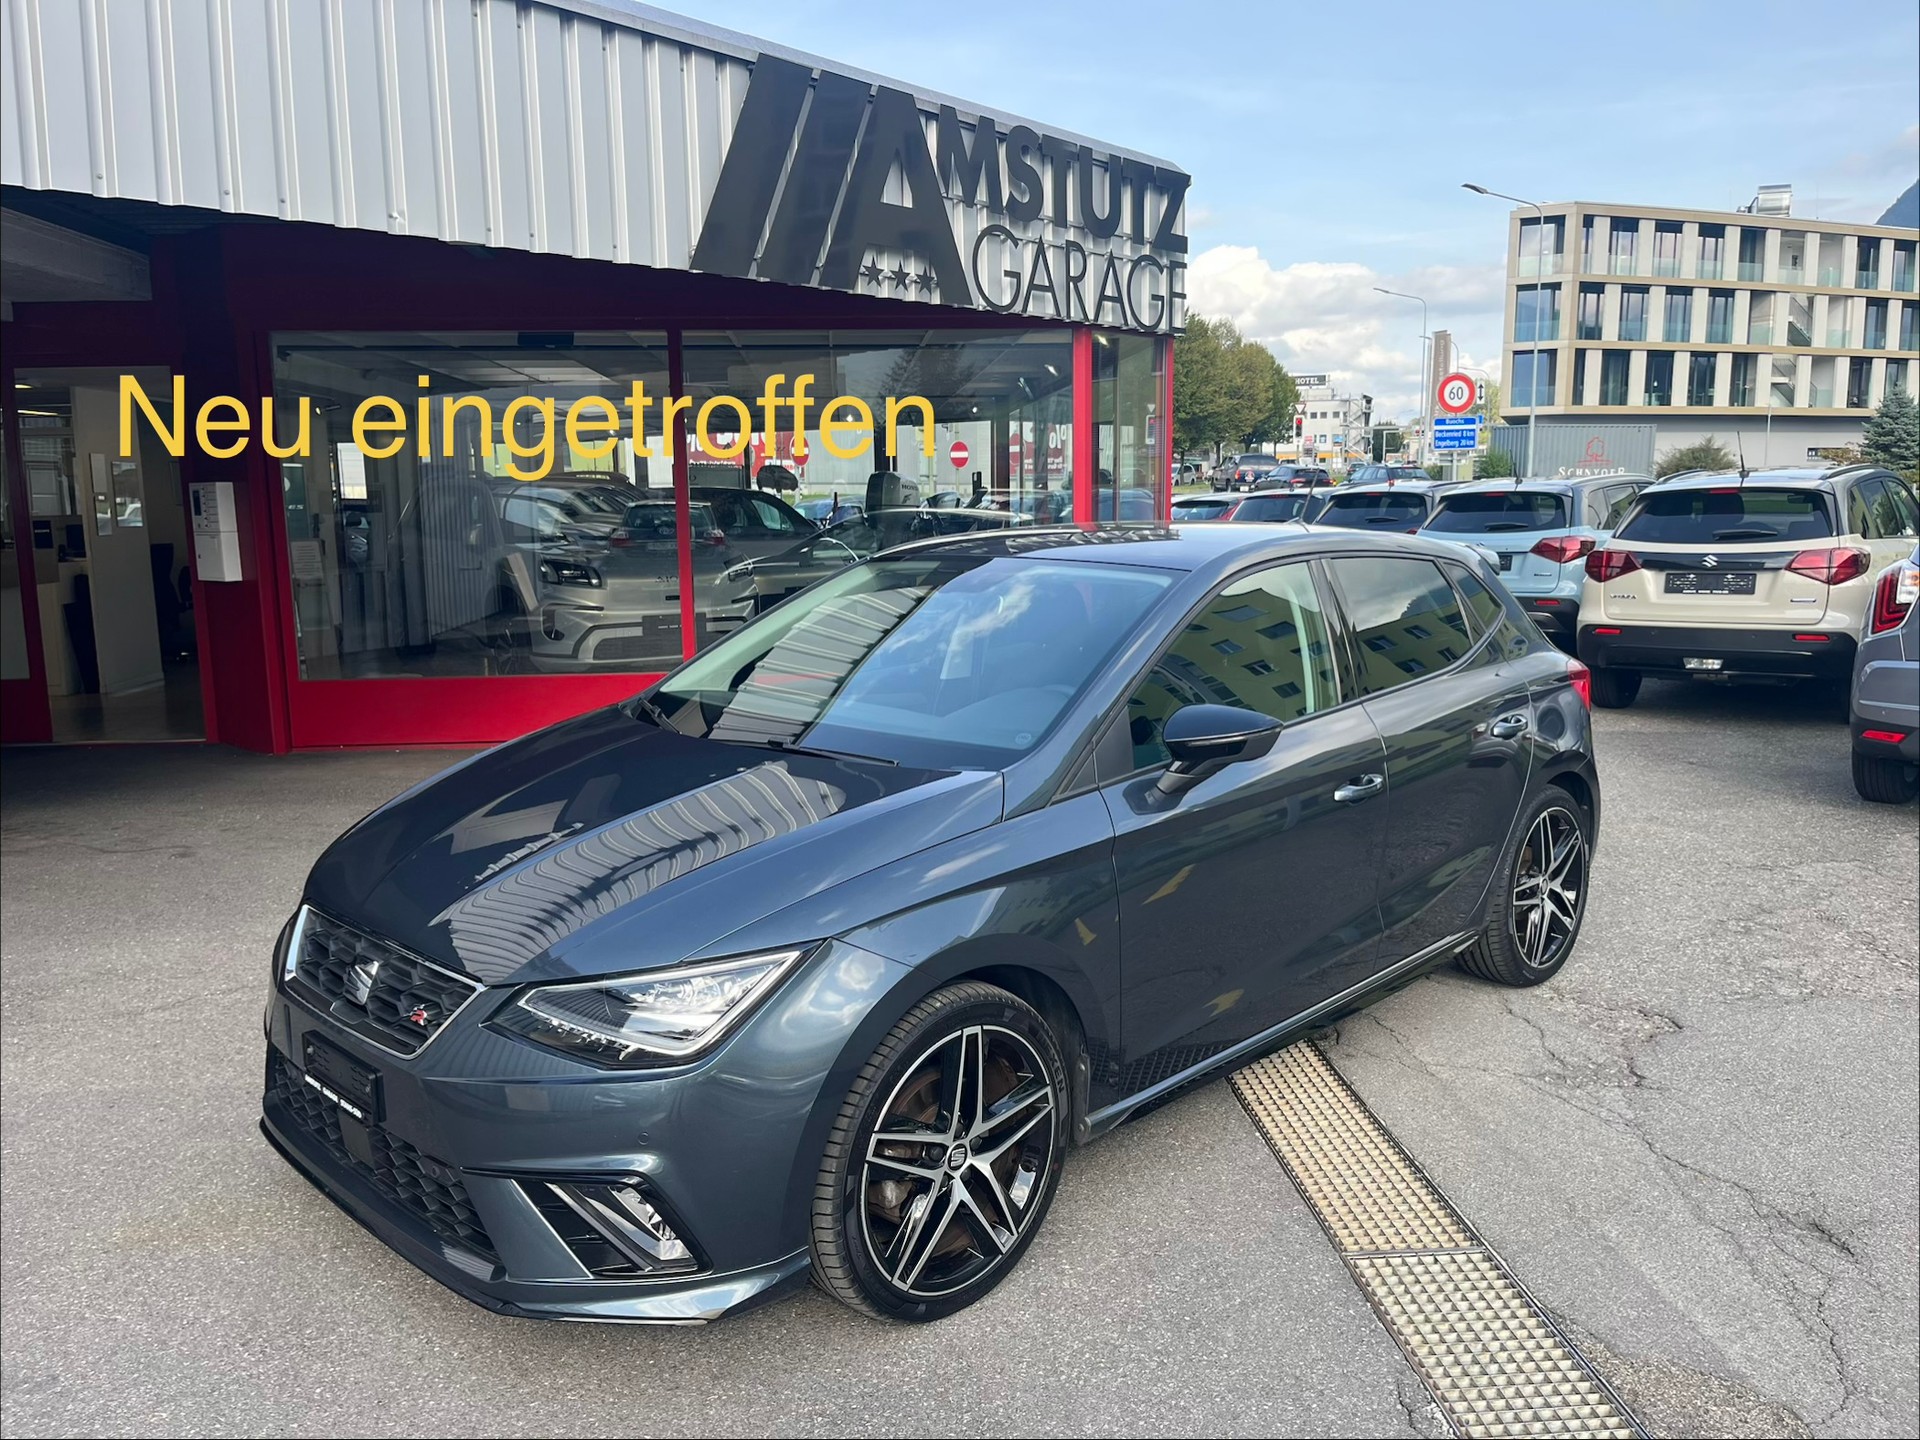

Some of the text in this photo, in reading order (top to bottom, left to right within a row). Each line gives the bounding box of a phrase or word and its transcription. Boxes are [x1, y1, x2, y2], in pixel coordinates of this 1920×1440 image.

[818, 84, 1192, 306] AMSTUTZ
[972, 224, 1188, 335] GARAGE
[1295, 377, 1320, 385] HOTEL
[1448, 386, 1464, 401] 60
[1435, 430, 1462, 438] Beckenried
[1435, 439, 1460, 448] Engelberg
